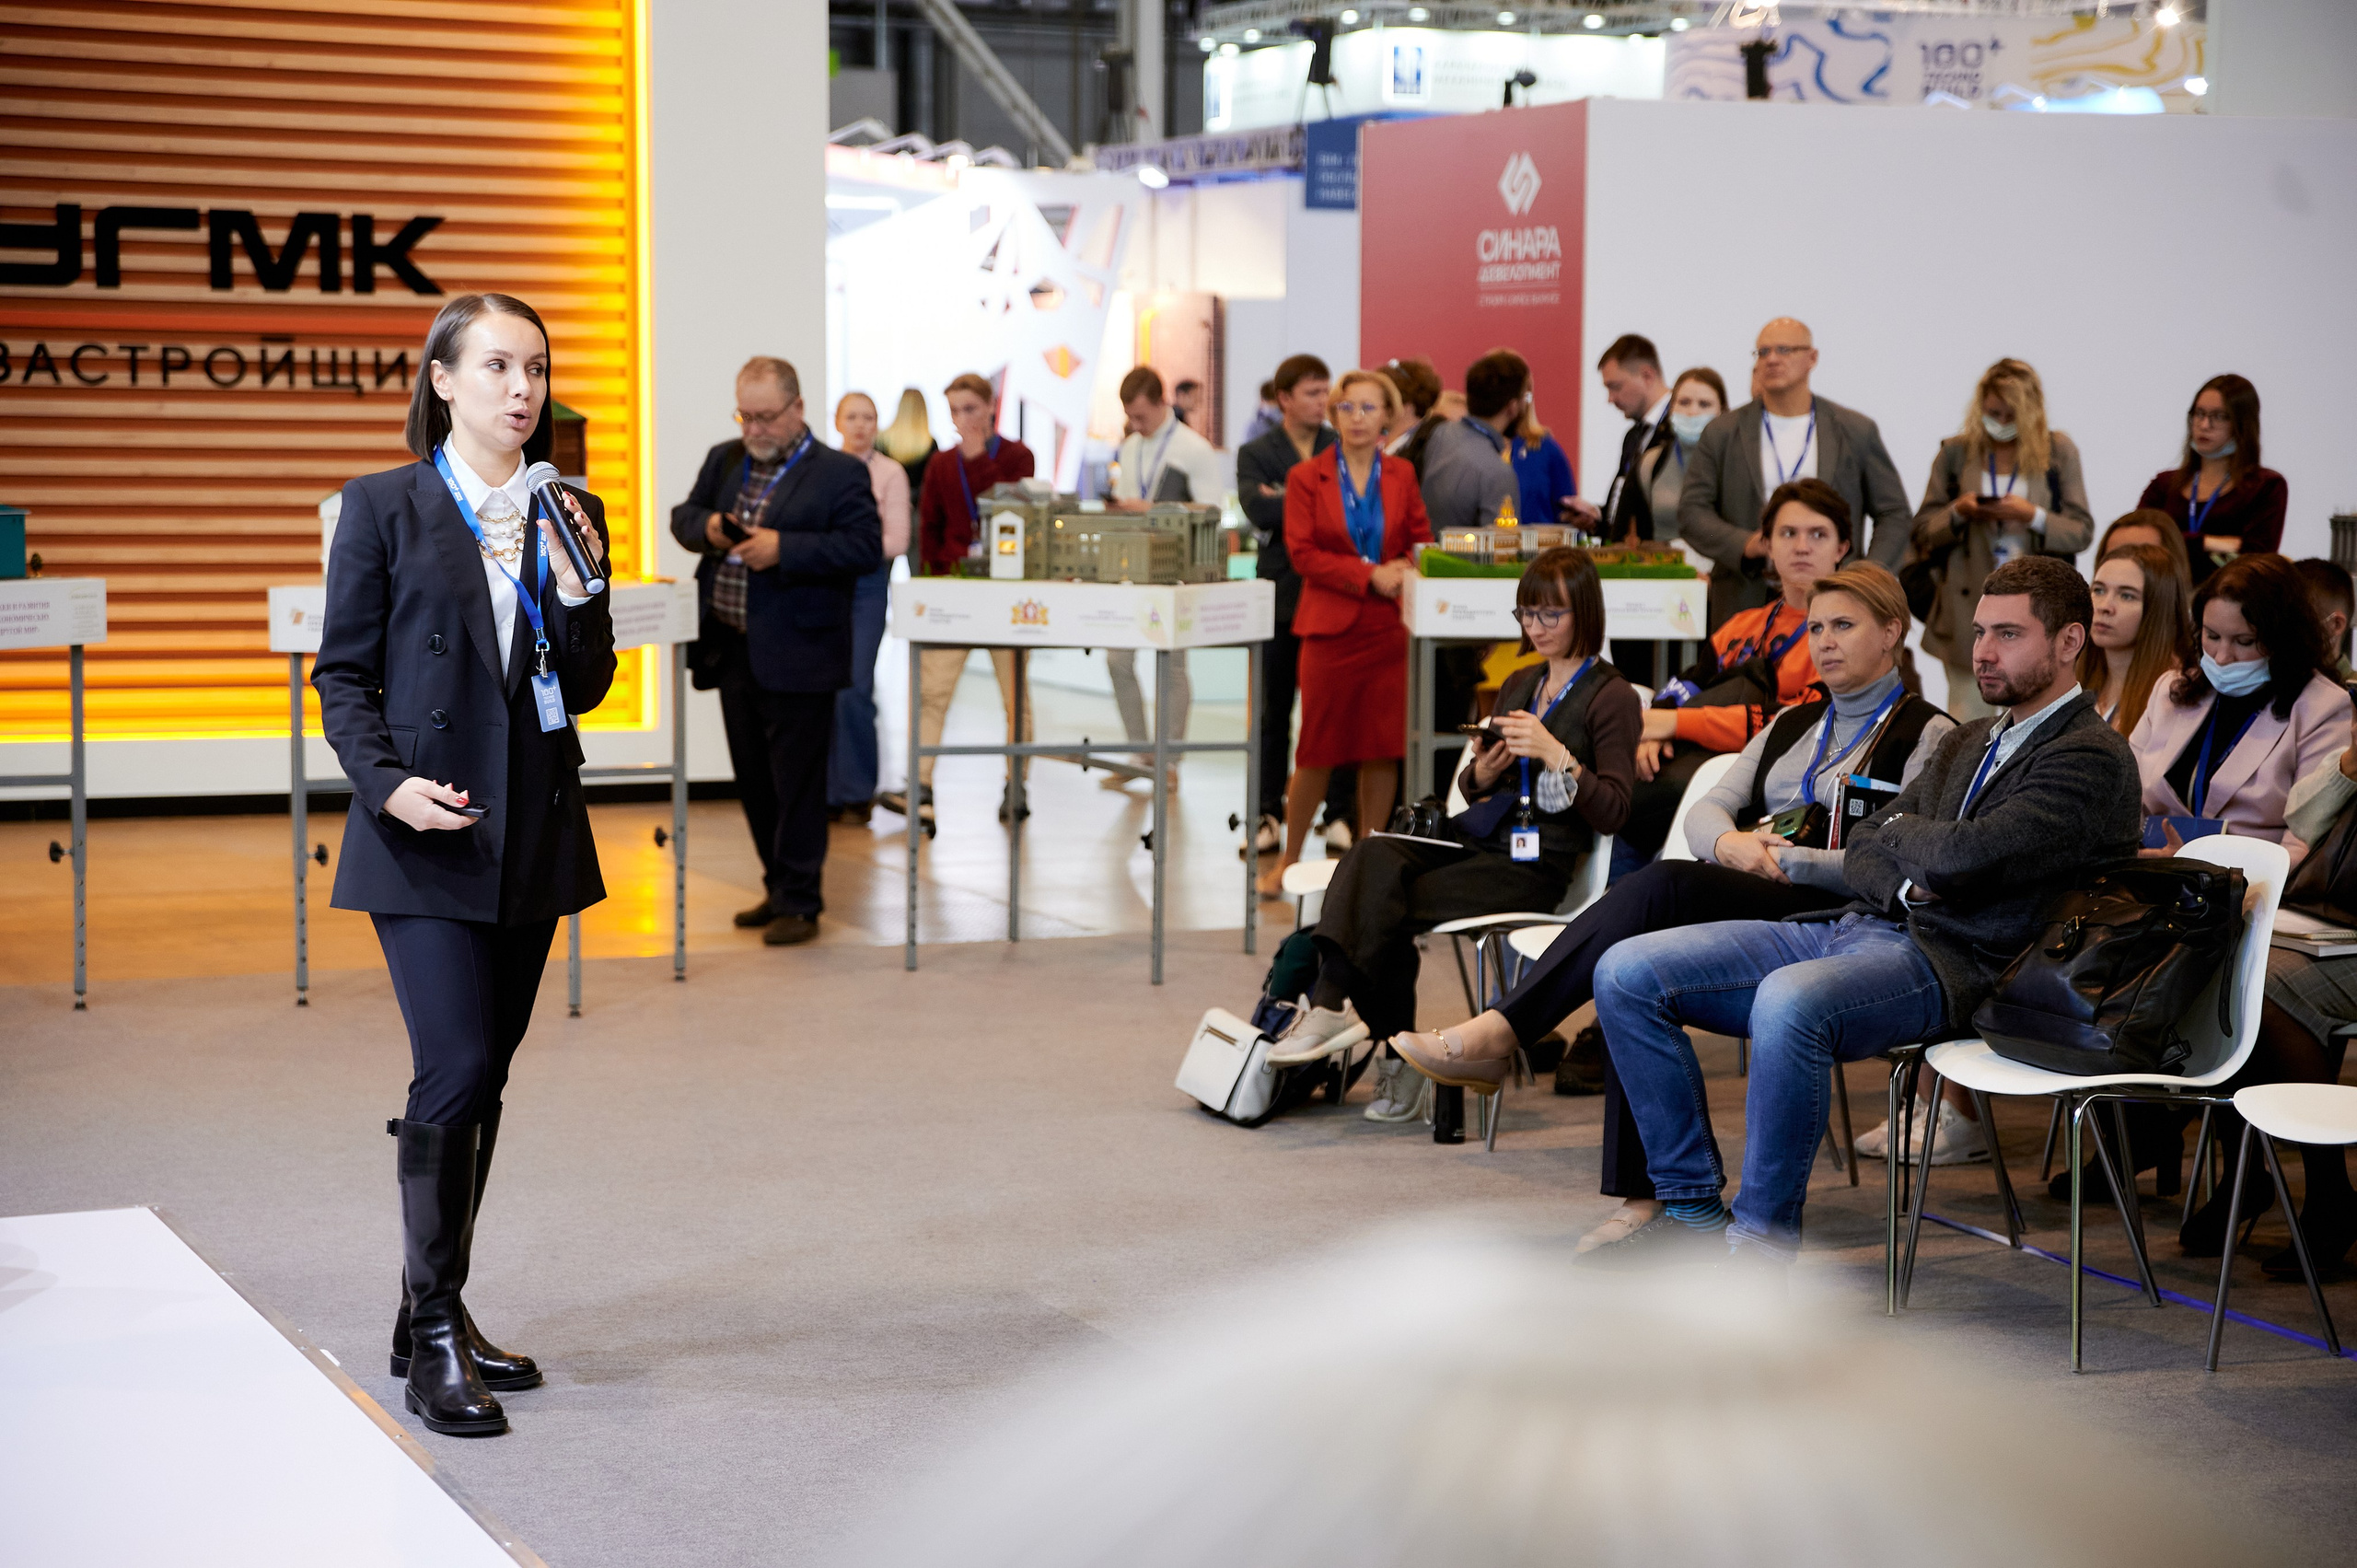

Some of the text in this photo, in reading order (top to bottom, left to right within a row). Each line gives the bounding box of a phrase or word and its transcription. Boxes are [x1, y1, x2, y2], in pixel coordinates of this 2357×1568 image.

[0, 203, 446, 296] УГМК
[1477, 226, 1562, 262] СИНАРА
[0, 335, 411, 398] АСТРОЙЩИ
[540, 685, 557, 696] 100+
